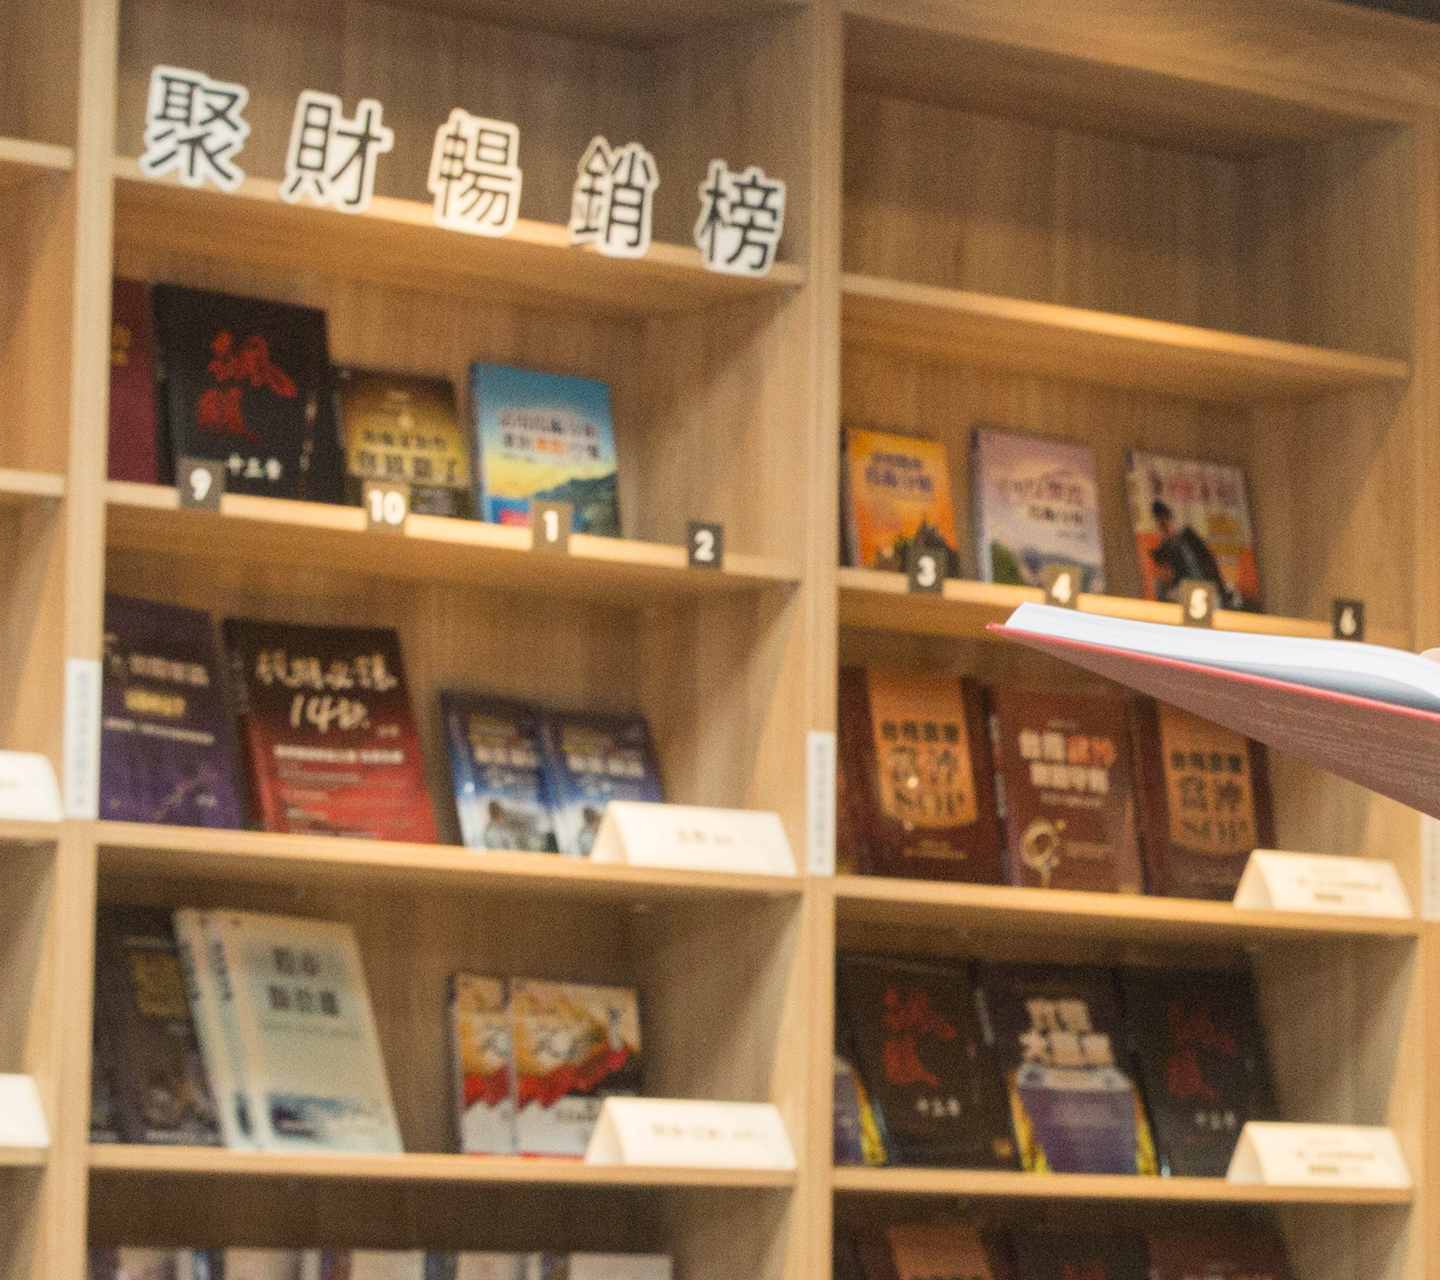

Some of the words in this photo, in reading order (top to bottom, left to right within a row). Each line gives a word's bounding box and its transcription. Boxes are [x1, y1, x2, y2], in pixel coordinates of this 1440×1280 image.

[144, 70, 784, 271] 聚財暢銷榜
[190, 468, 212, 500] 9
[369, 489, 406, 525] 10
[543, 510, 559, 542] 1
[695, 530, 715, 561] 2
[917, 556, 936, 587] 3
[1052, 574, 1071, 602] 4
[1190, 588, 1208, 619] 5
[1340, 609, 1356, 635] 6
